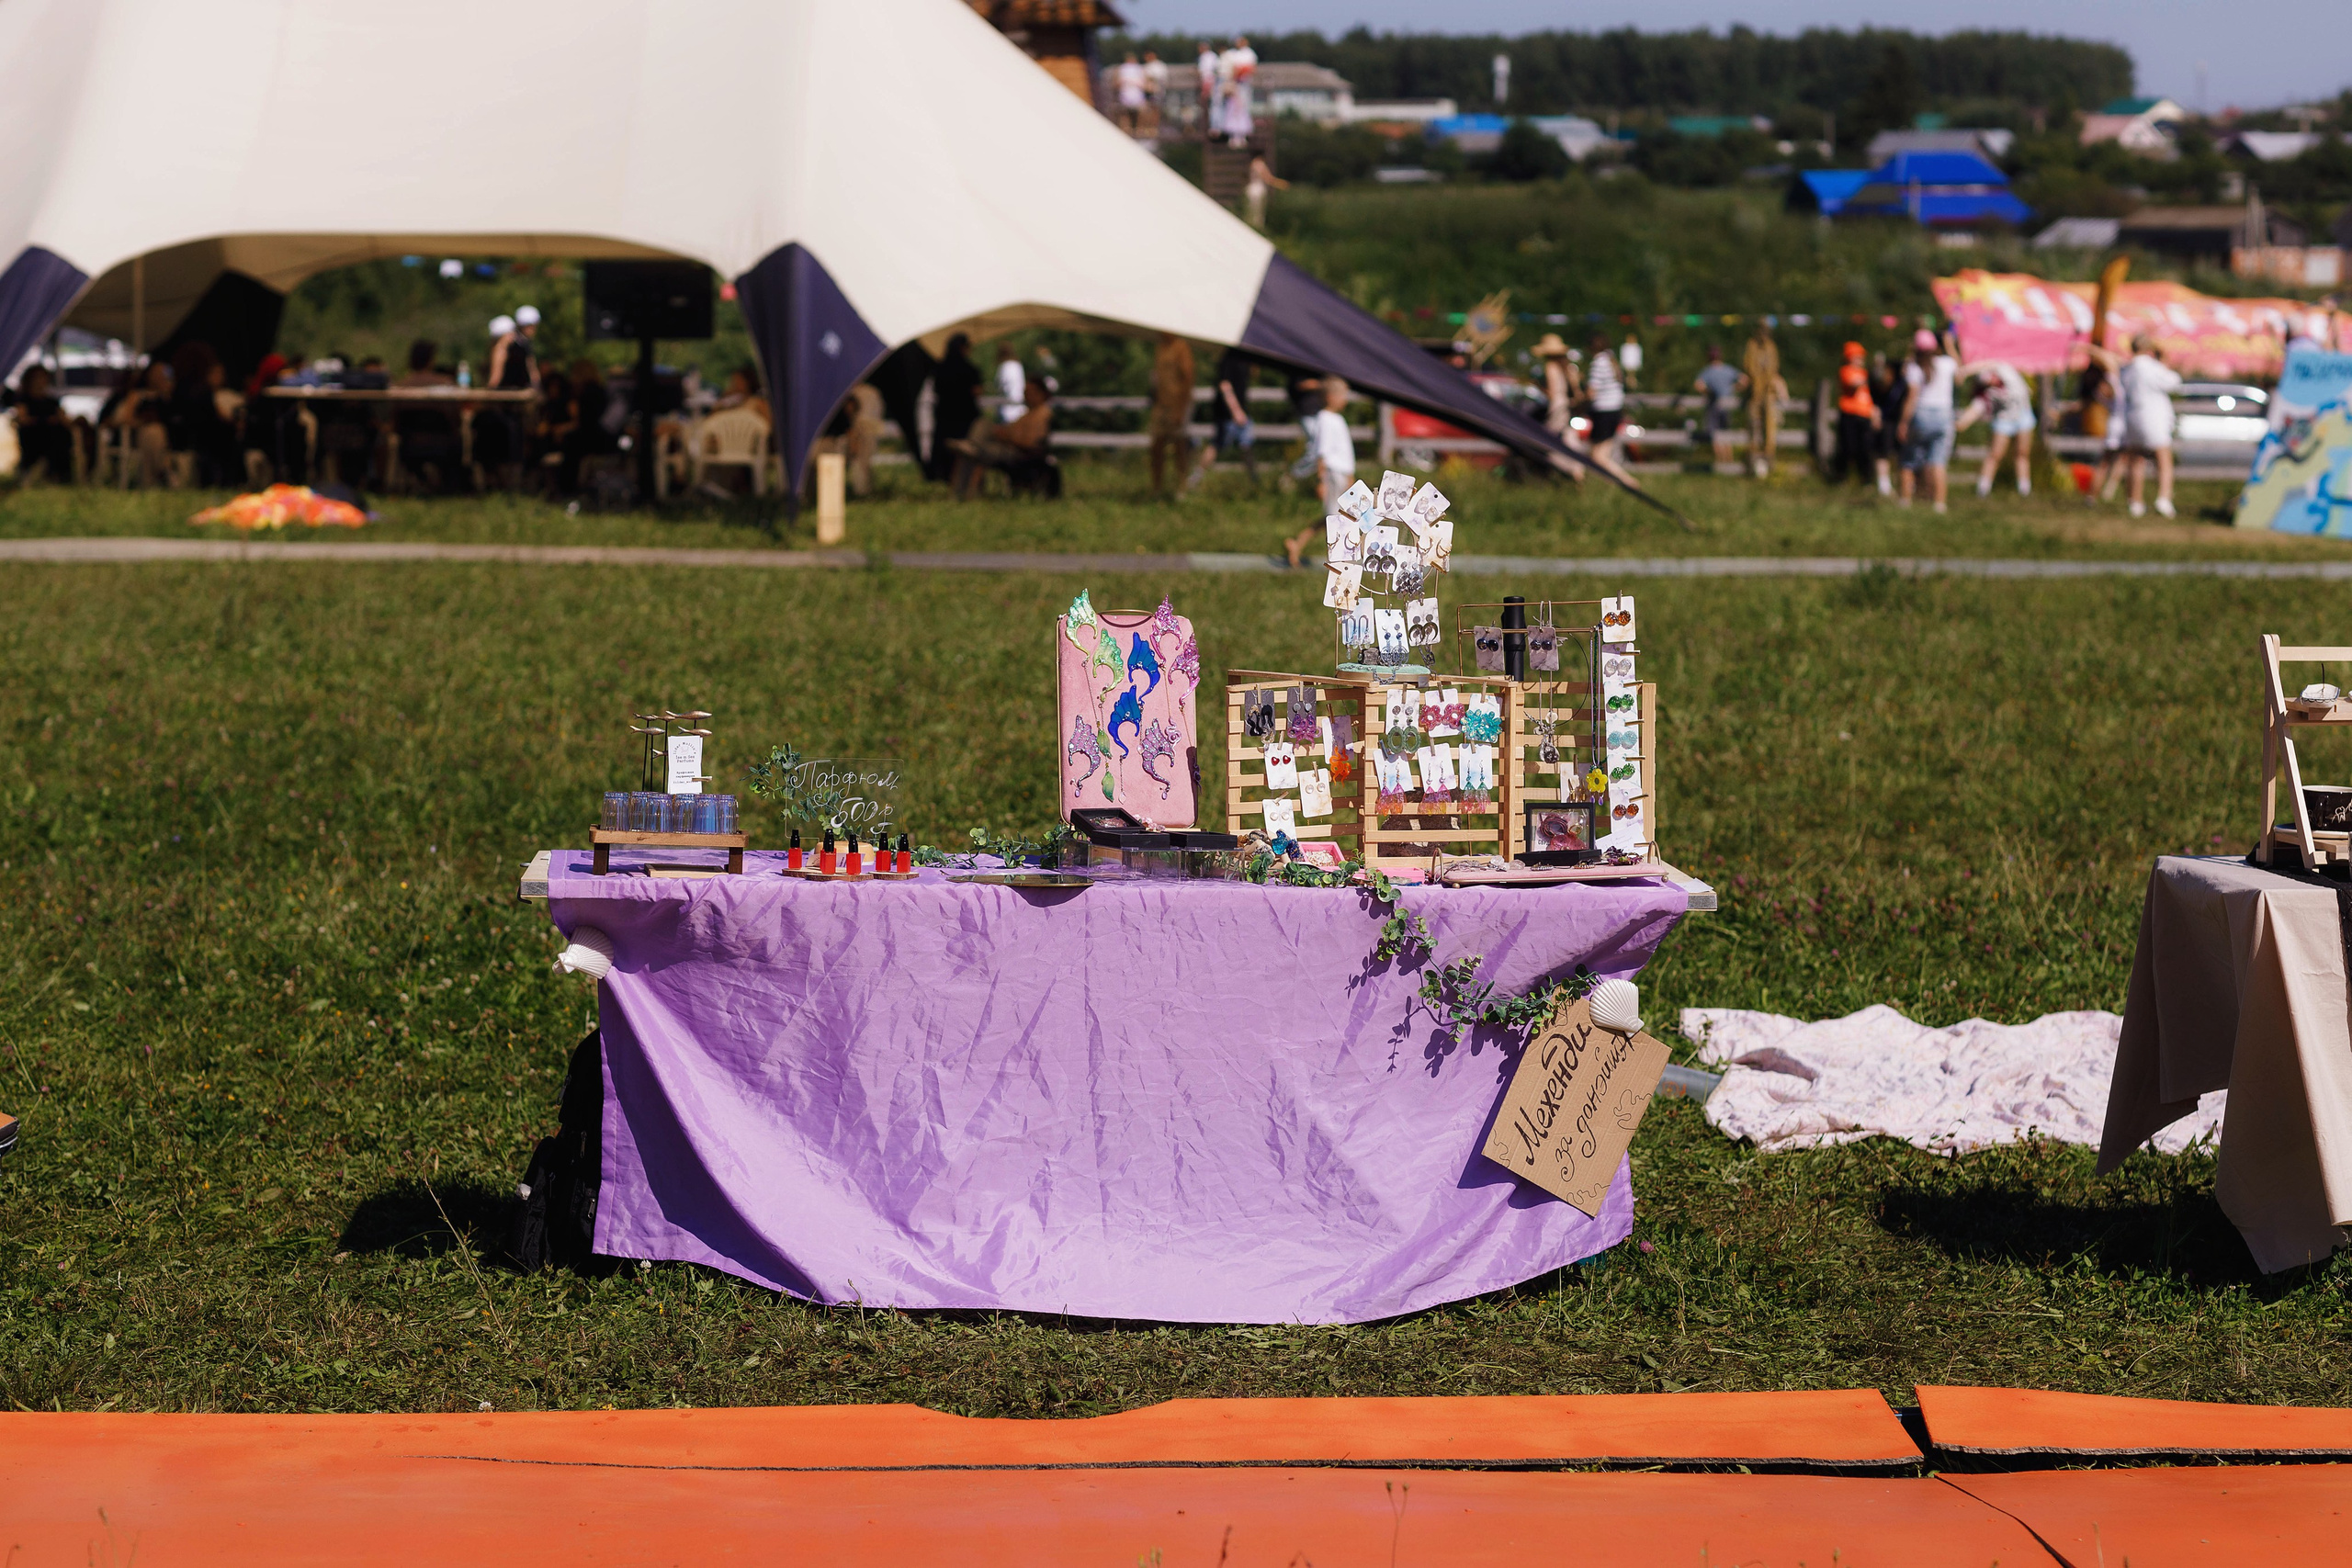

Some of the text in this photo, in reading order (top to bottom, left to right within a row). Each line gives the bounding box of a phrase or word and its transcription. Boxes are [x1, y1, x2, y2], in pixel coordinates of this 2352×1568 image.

[790, 759, 899, 807] Парфюм
[1514, 1021, 1592, 1166] Мехенди
[1555, 1136, 1575, 1182] за
